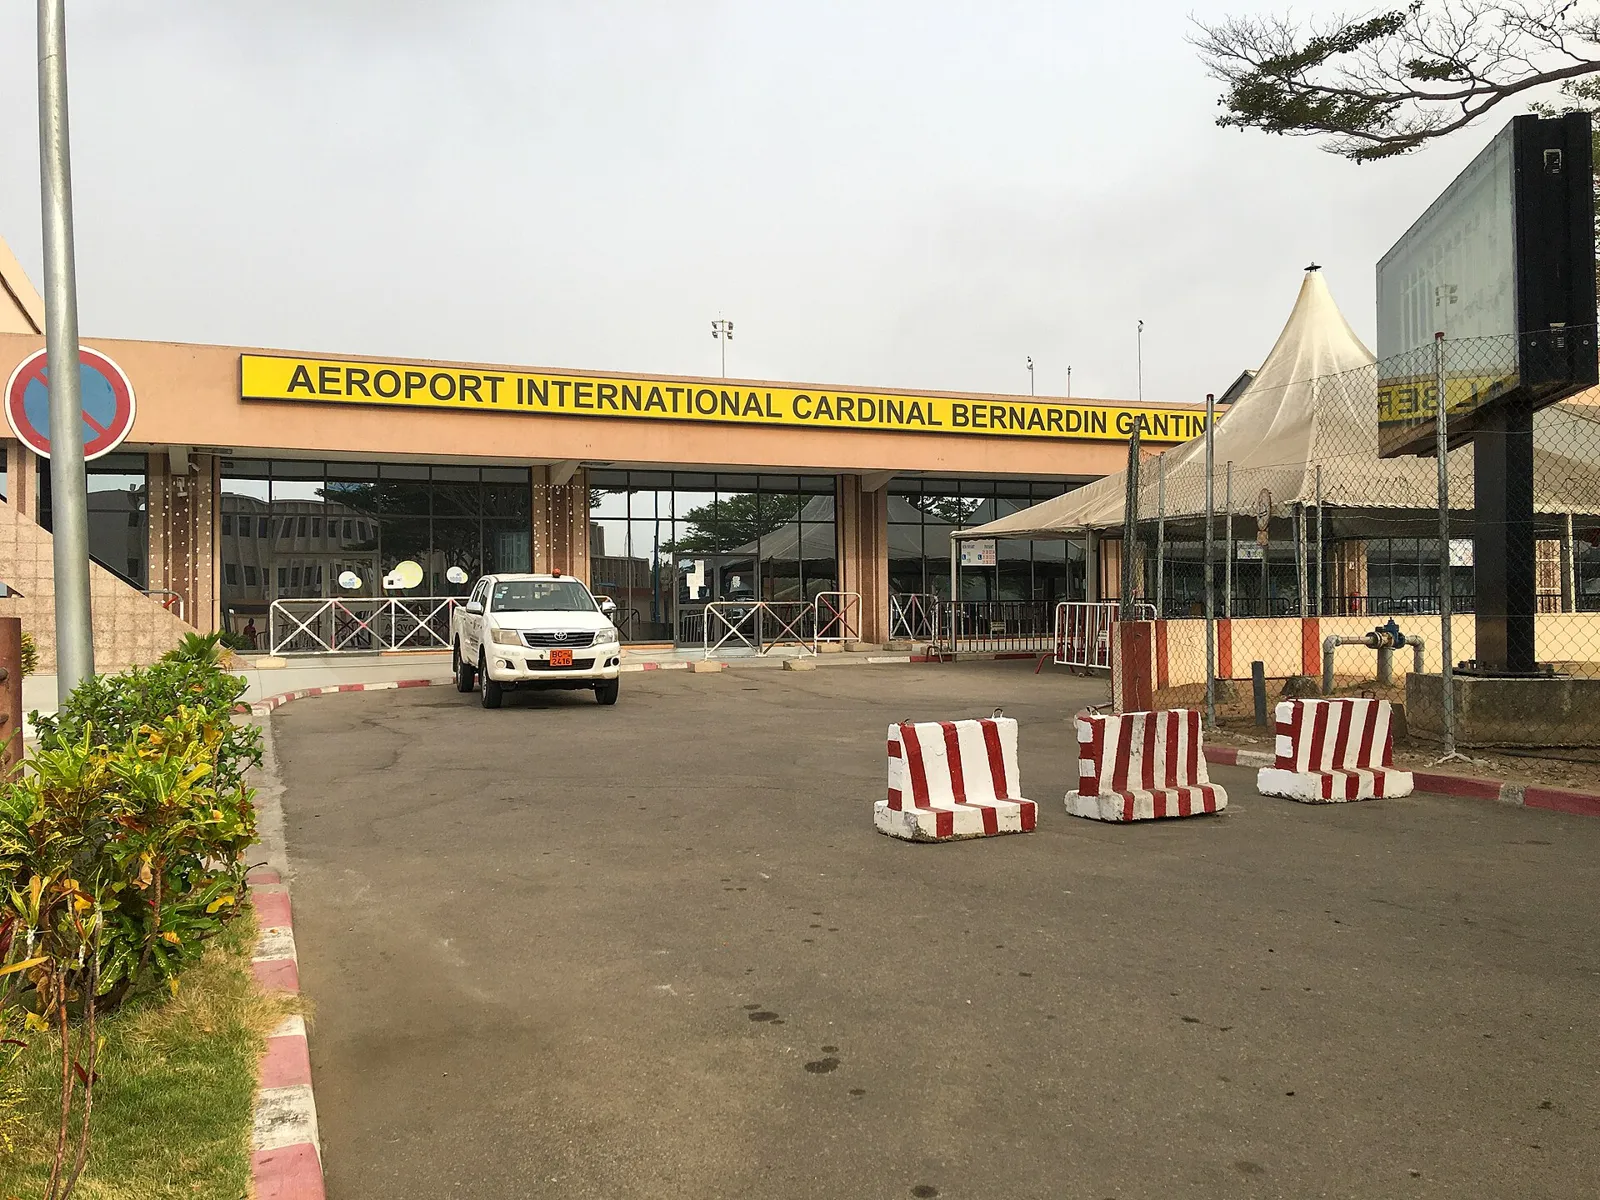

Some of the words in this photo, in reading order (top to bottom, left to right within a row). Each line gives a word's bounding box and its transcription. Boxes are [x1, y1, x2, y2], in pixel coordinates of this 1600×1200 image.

[287, 364, 504, 403] AEROPORT
[517, 378, 782, 418] INTERNATIONAL
[792, 394, 942, 426] CARDINAL
[952, 403, 1107, 433] BERNARDIN
[1116, 411, 1221, 437] GANTIN
